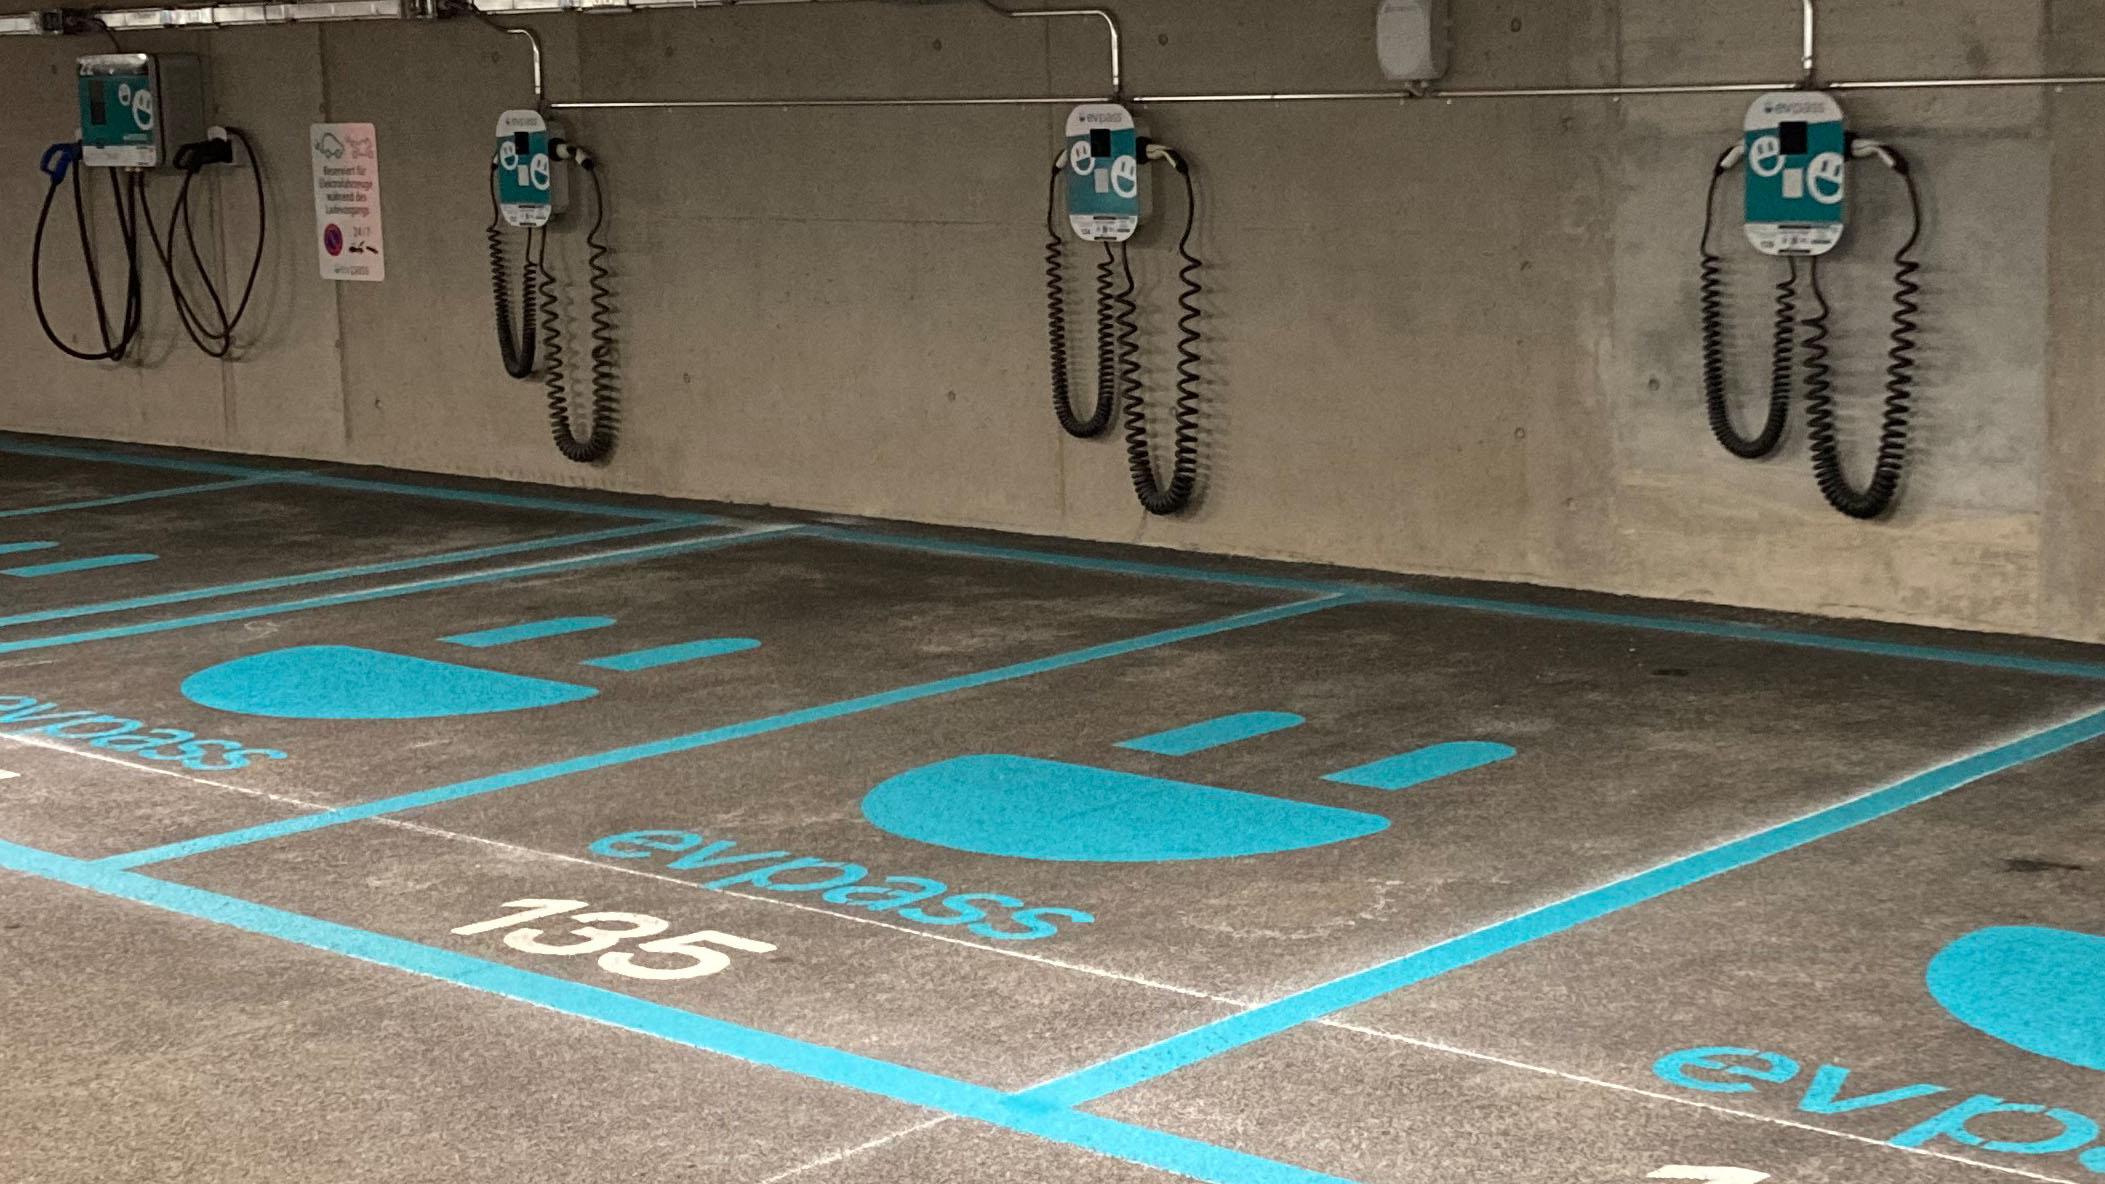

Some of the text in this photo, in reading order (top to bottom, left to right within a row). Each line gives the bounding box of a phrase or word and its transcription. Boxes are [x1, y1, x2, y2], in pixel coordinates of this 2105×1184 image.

[451, 898, 778, 981] 135
[588, 829, 1095, 940] evpass
[1652, 1045, 2105, 1173] evp
